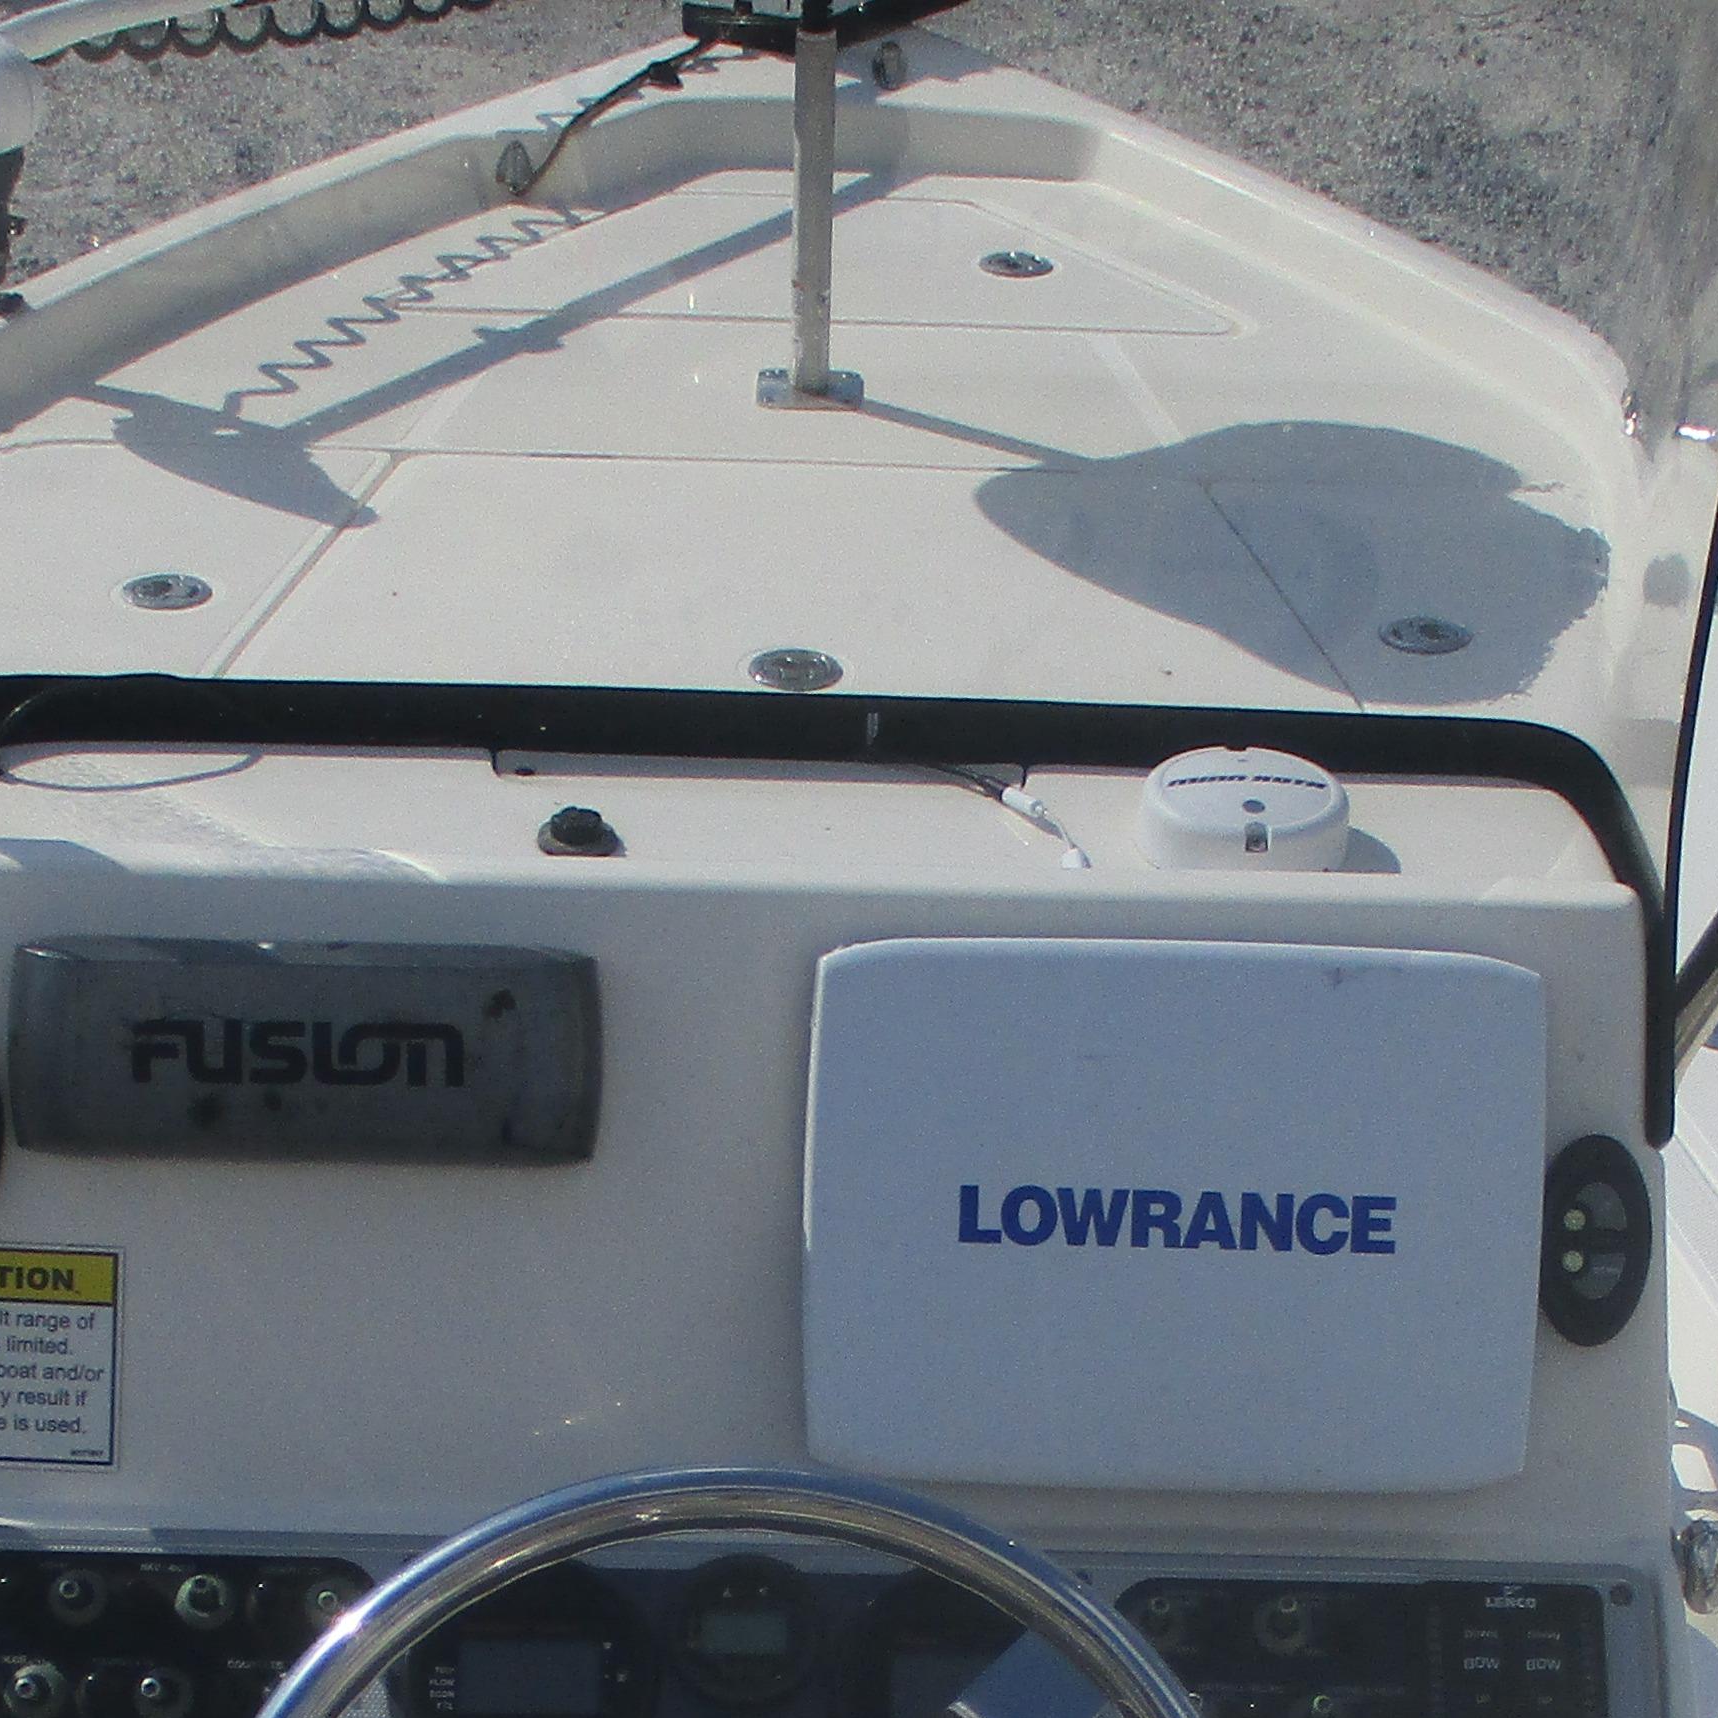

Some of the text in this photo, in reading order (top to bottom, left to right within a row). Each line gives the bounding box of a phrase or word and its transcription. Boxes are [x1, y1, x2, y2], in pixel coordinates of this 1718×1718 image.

[957, 1182, 1398, 1256] LOWRANCE
[16, 1313, 71, 1332] range
[77, 1313, 96, 1330] of
[6, 1336, 73, 1355] limited.
[42, 1364, 105, 1382] and/or
[17, 1389, 70, 1406] result
[75, 1389, 88, 1406] if
[14, 1417, 29, 1431] is
[35, 1418, 87, 1434] used.
